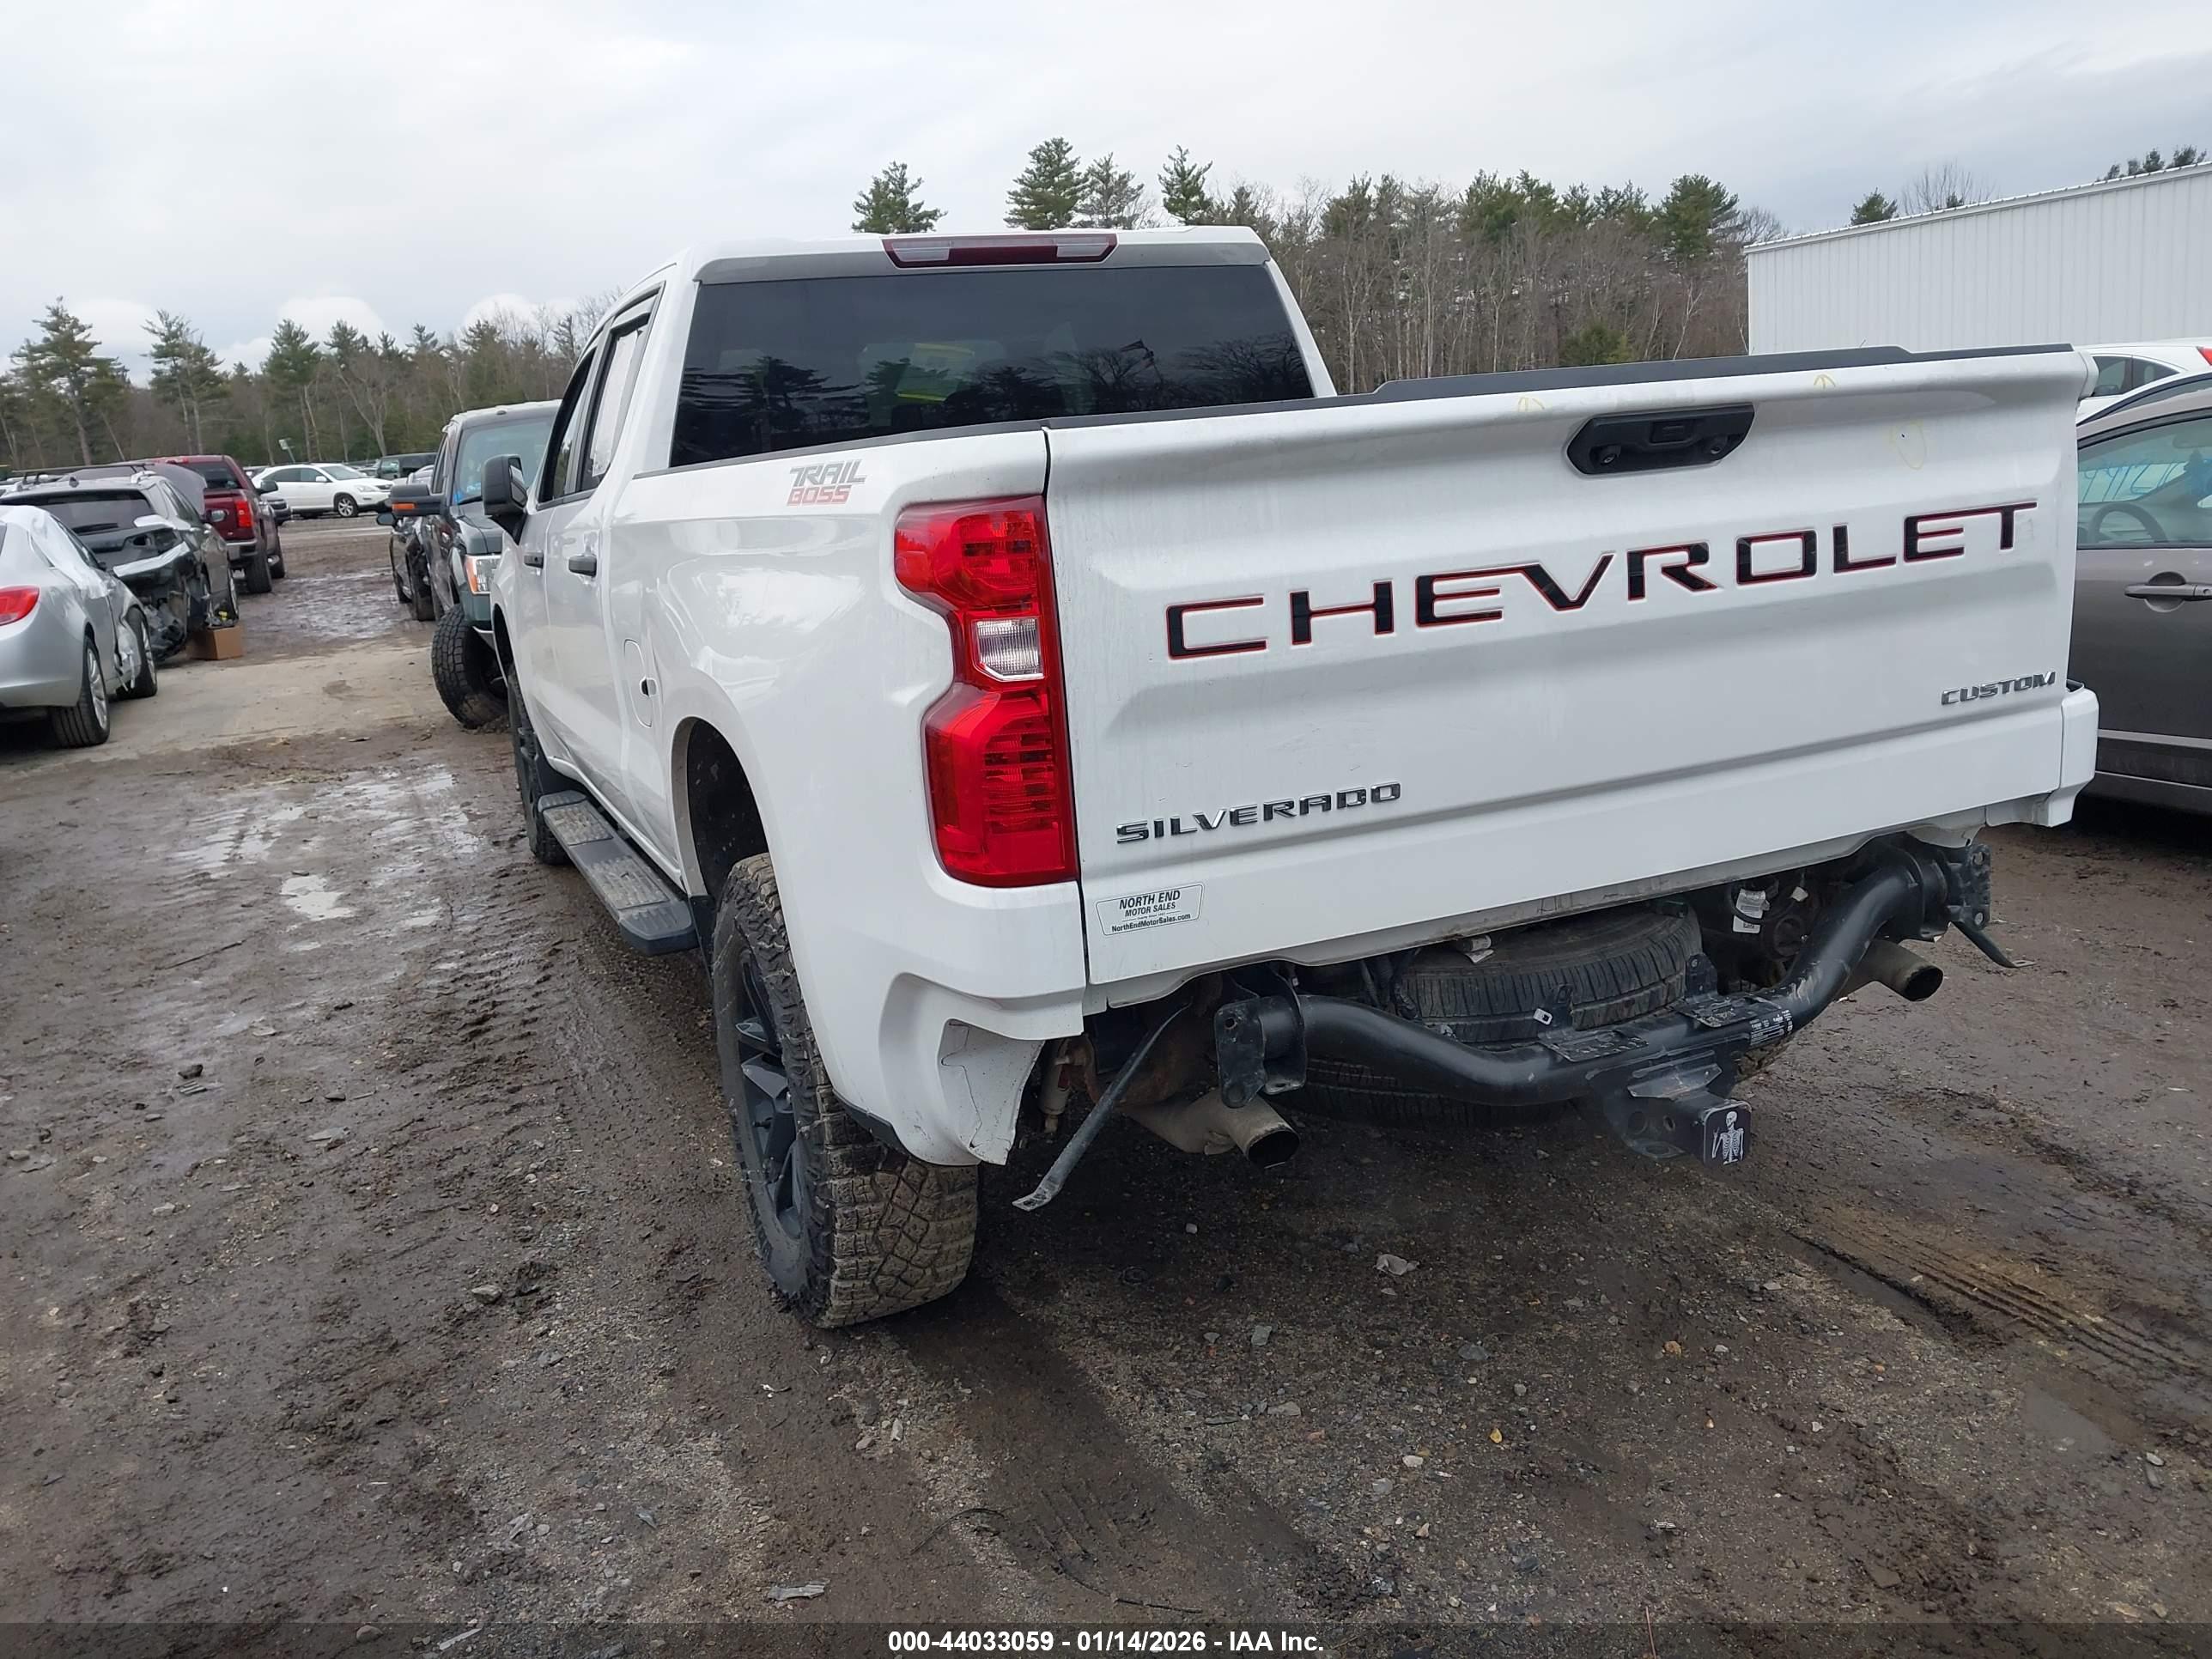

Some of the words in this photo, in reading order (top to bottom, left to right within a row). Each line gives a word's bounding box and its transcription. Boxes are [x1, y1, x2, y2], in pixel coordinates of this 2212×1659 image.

[789, 459, 867, 488] TRAIL
[787, 484, 852, 507] BOSS
[1166, 501, 2038, 659] CHEVROLET
[1941, 671, 2056, 705] CUSTOM
[1116, 781, 1401, 844] SILVERADO
[1119, 893, 1156, 909] NORTH
[1158, 890, 1181, 903] END
[1125, 906, 1151, 917] MOTOR
[1153, 902, 1176, 913] SALES
[1111, 913, 1191, 933] NorthEndMotorSales.com
